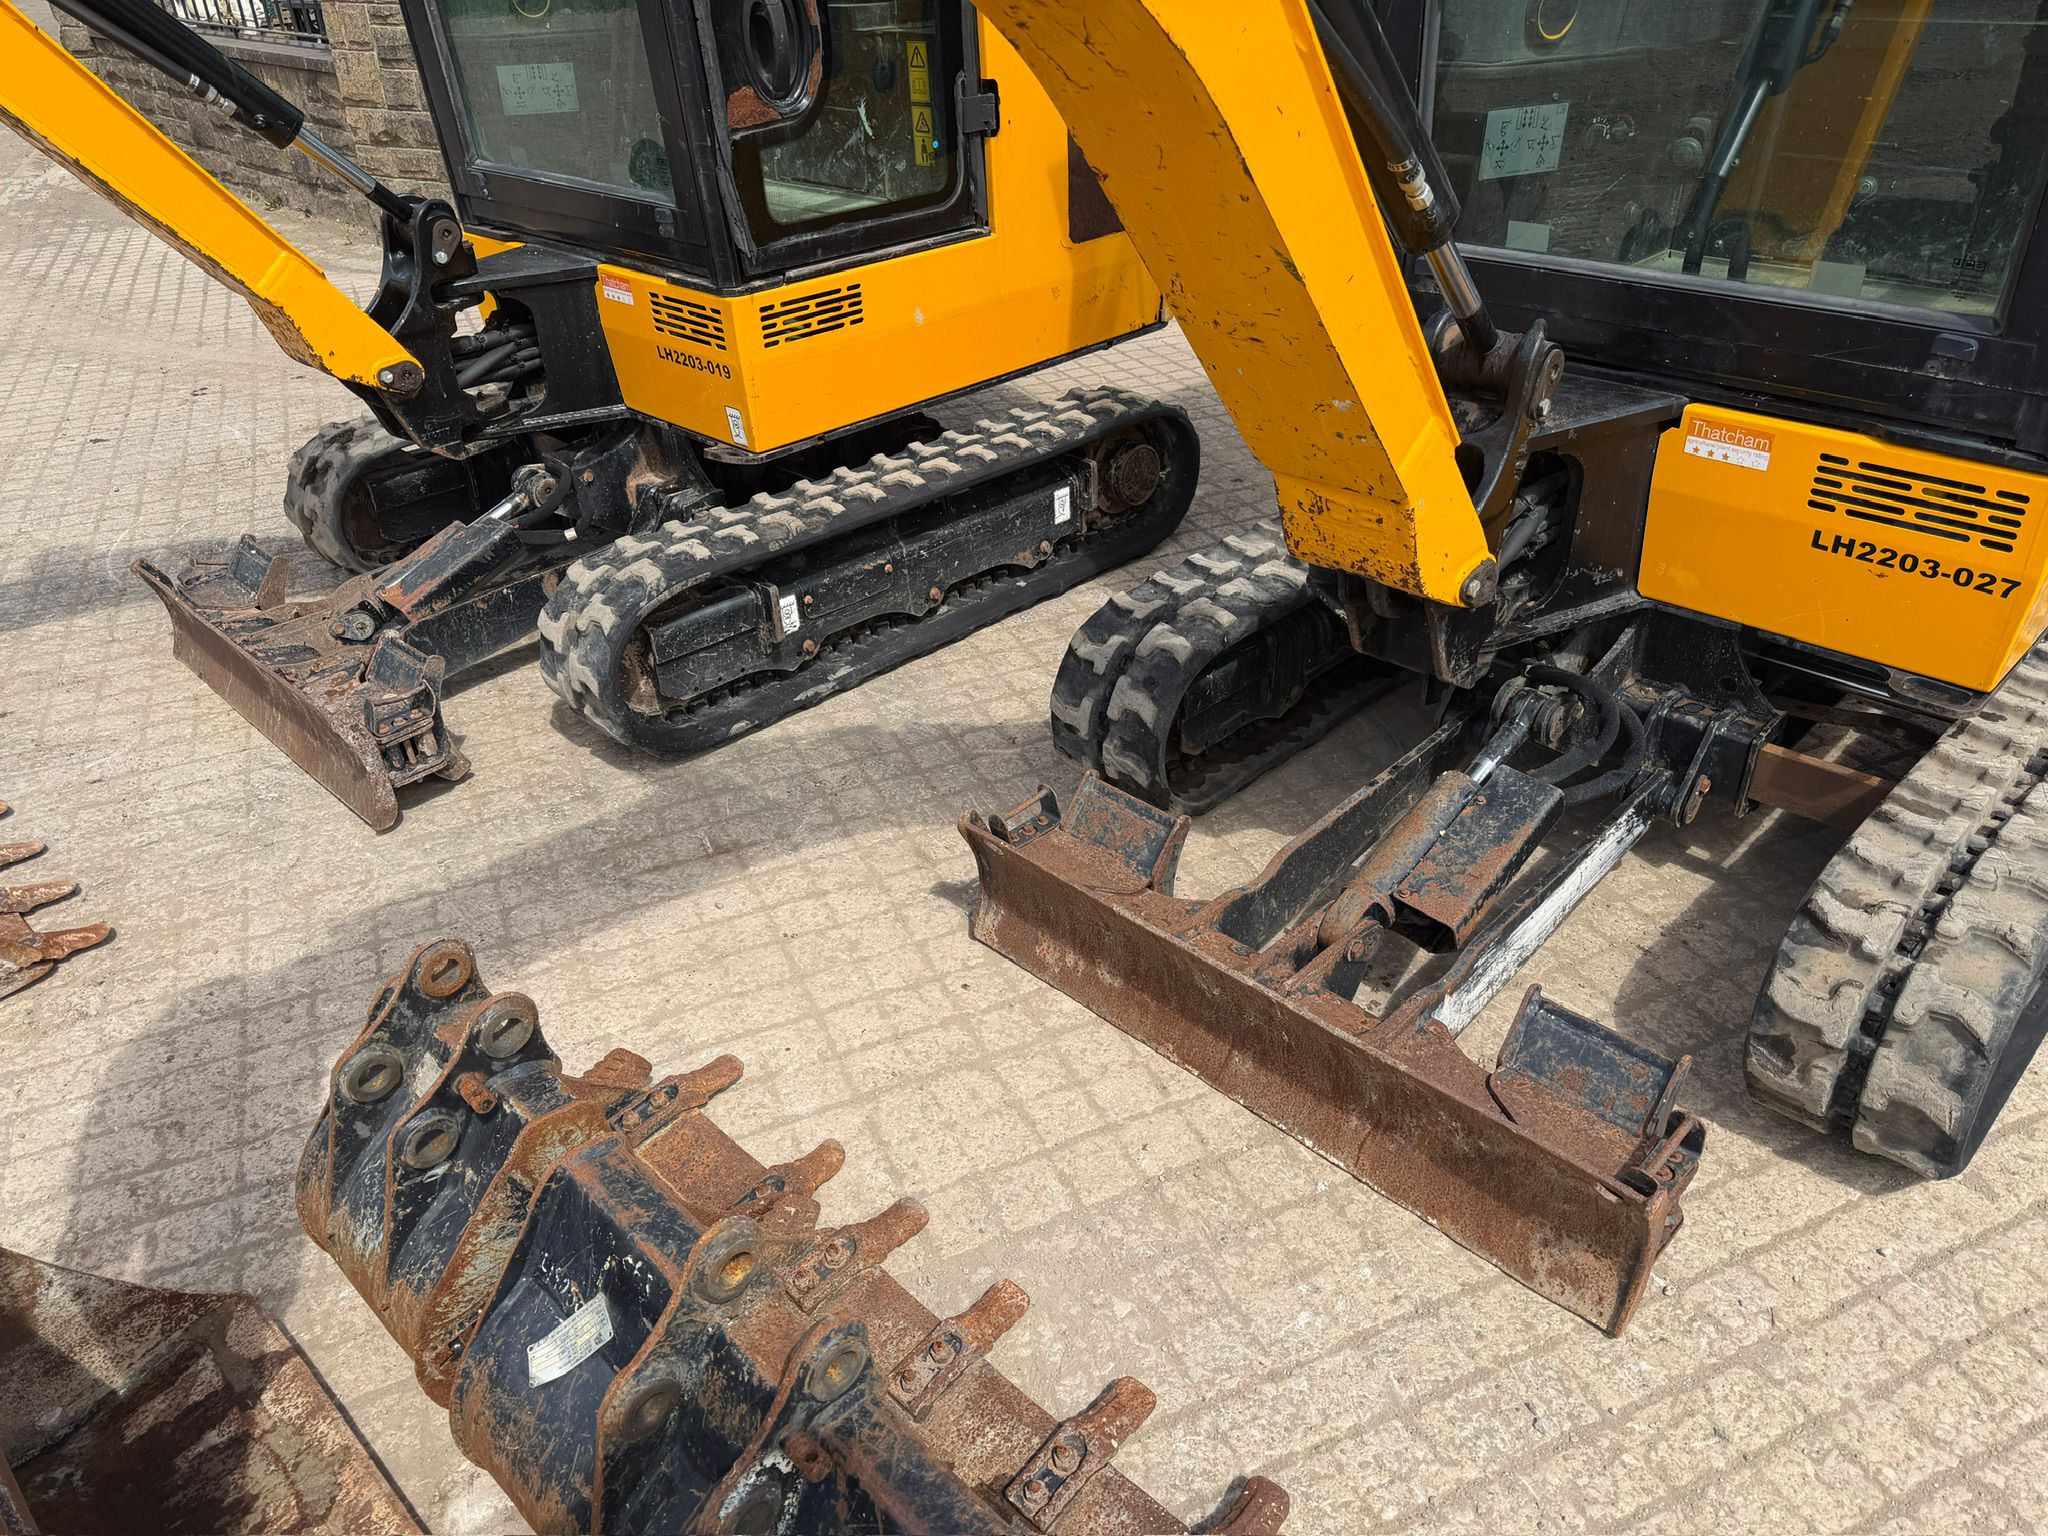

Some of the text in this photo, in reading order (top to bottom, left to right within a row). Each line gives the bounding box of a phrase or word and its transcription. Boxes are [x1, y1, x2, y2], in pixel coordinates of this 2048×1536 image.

[601, 273, 631, 292] Thatcham
[656, 345, 731, 379] LH2203-019
[1692, 420, 1769, 451] Thatcham
[1811, 529, 2022, 599] LH2203-027
